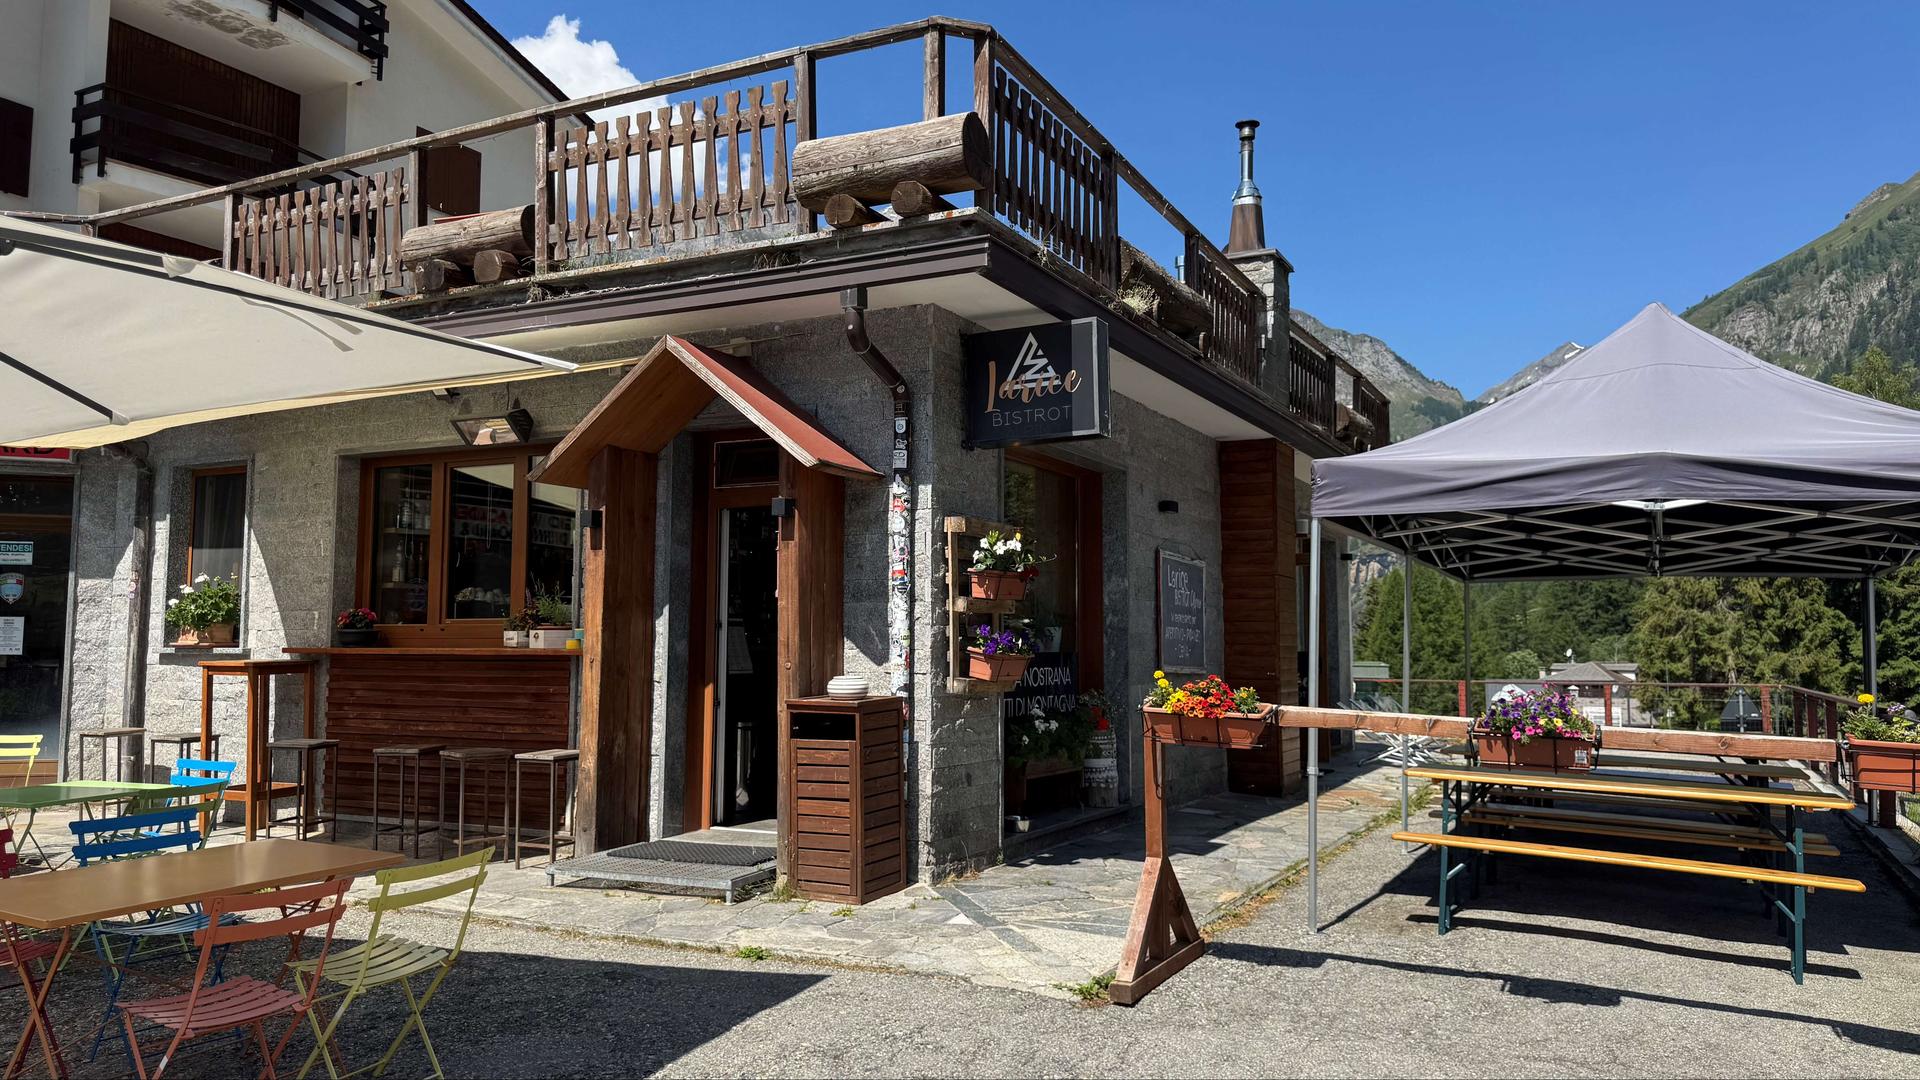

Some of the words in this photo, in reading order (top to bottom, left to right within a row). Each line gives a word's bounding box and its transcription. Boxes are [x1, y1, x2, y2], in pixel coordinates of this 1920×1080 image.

[985, 360, 1082, 413] Larice
[992, 405, 1072, 427] BISTROT
[1024, 667, 1072, 687] NOSTRANA
[1015, 697, 1026, 717] DI
[1027, 694, 1077, 716] MONTAGNA
